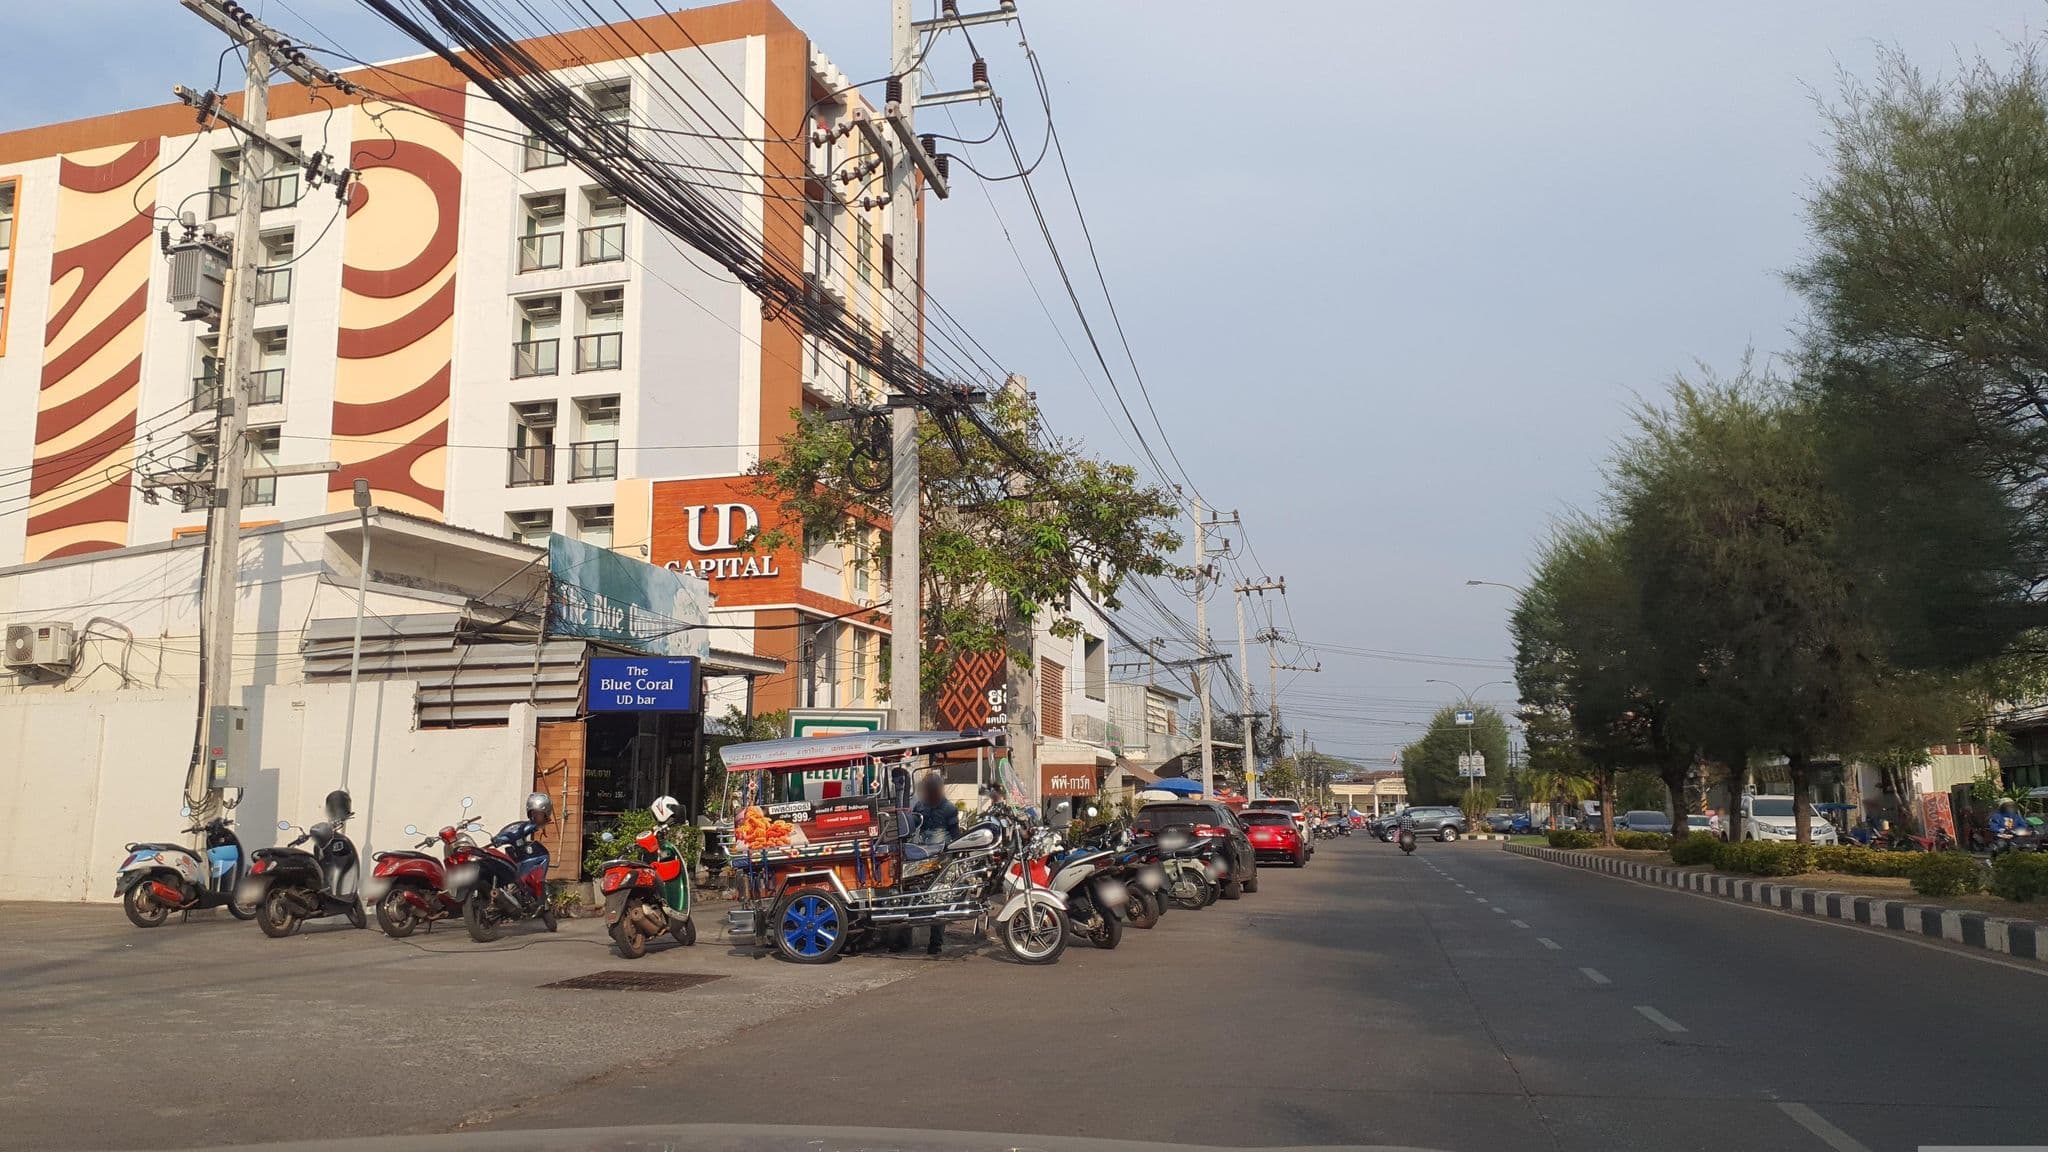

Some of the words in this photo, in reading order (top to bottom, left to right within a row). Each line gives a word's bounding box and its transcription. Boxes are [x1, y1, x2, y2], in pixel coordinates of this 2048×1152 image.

[683, 503, 759, 552] UD
[626, 666, 649, 676] The
[601, 678, 632, 691] Blue
[636, 678, 673, 691] Coral
[616, 695, 633, 705] UD
[637, 695, 656, 705] bar
